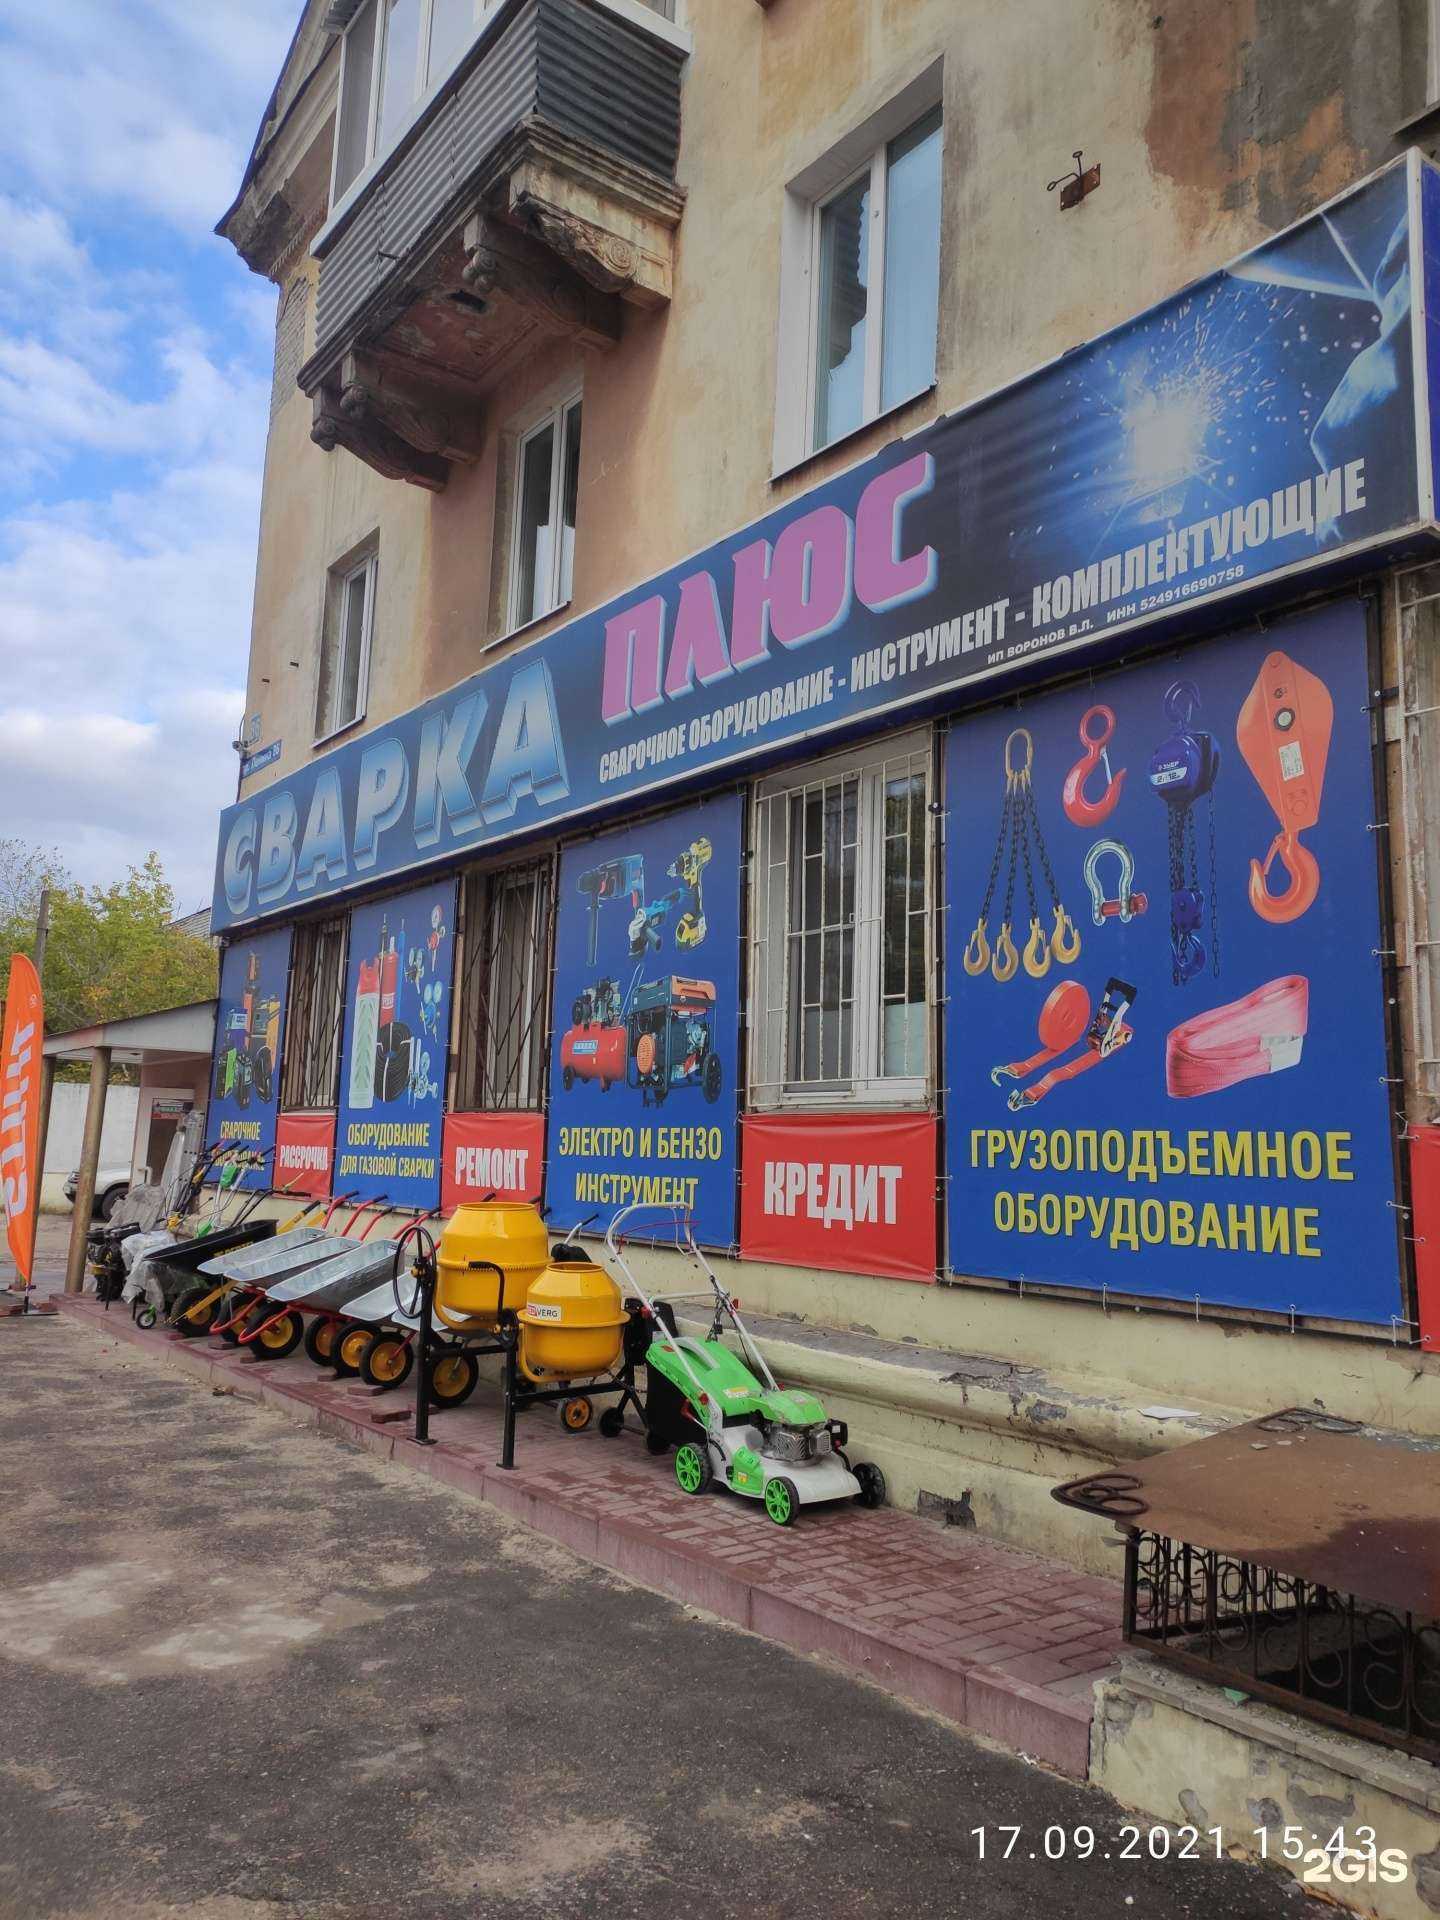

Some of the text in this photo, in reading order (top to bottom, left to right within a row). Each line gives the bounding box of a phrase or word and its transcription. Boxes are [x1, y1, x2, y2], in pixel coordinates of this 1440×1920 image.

[599, 724, 686, 785] СВАРОЧНОЕ
[688, 665, 835, 750] ОБОРУДОВАНИЕ
[849, 597, 1011, 695] ИНСТРУМЕНТ
[1032, 457, 1367, 629] КОМПЛЕКТУЮЩИЕ
[987, 650, 1004, 665] ИП
[1007, 627, 1066, 658] ВОРОНОВ
[1106, 604, 1136, 624] ИНН
[1140, 564, 1245, 612] 524916690758
[223, 450, 940, 914] СВАРКА ПЛЮС
[220, 1120, 262, 1141] СВАРОЧНОЕ
[347, 1121, 430, 1148] ОБОРУДОВАНИЕ
[558, 1127, 722, 1161] ЭЛЕКТРО И БЕНЗО
[970, 1128, 1355, 1183] ГРУЗОПОДЪЕМНОЕ
[339, 1154, 435, 1179] ДЛЯ ГАЗОВОЙ СВАРКИ
[455, 1146, 529, 1191] РЕМОНТ
[575, 1172, 699, 1210] ИНСТРУМЕНТ
[763, 1160, 903, 1231] КРЕДИТ
[993, 1190, 1323, 1258] ОБОРУДОВАНИЕ
